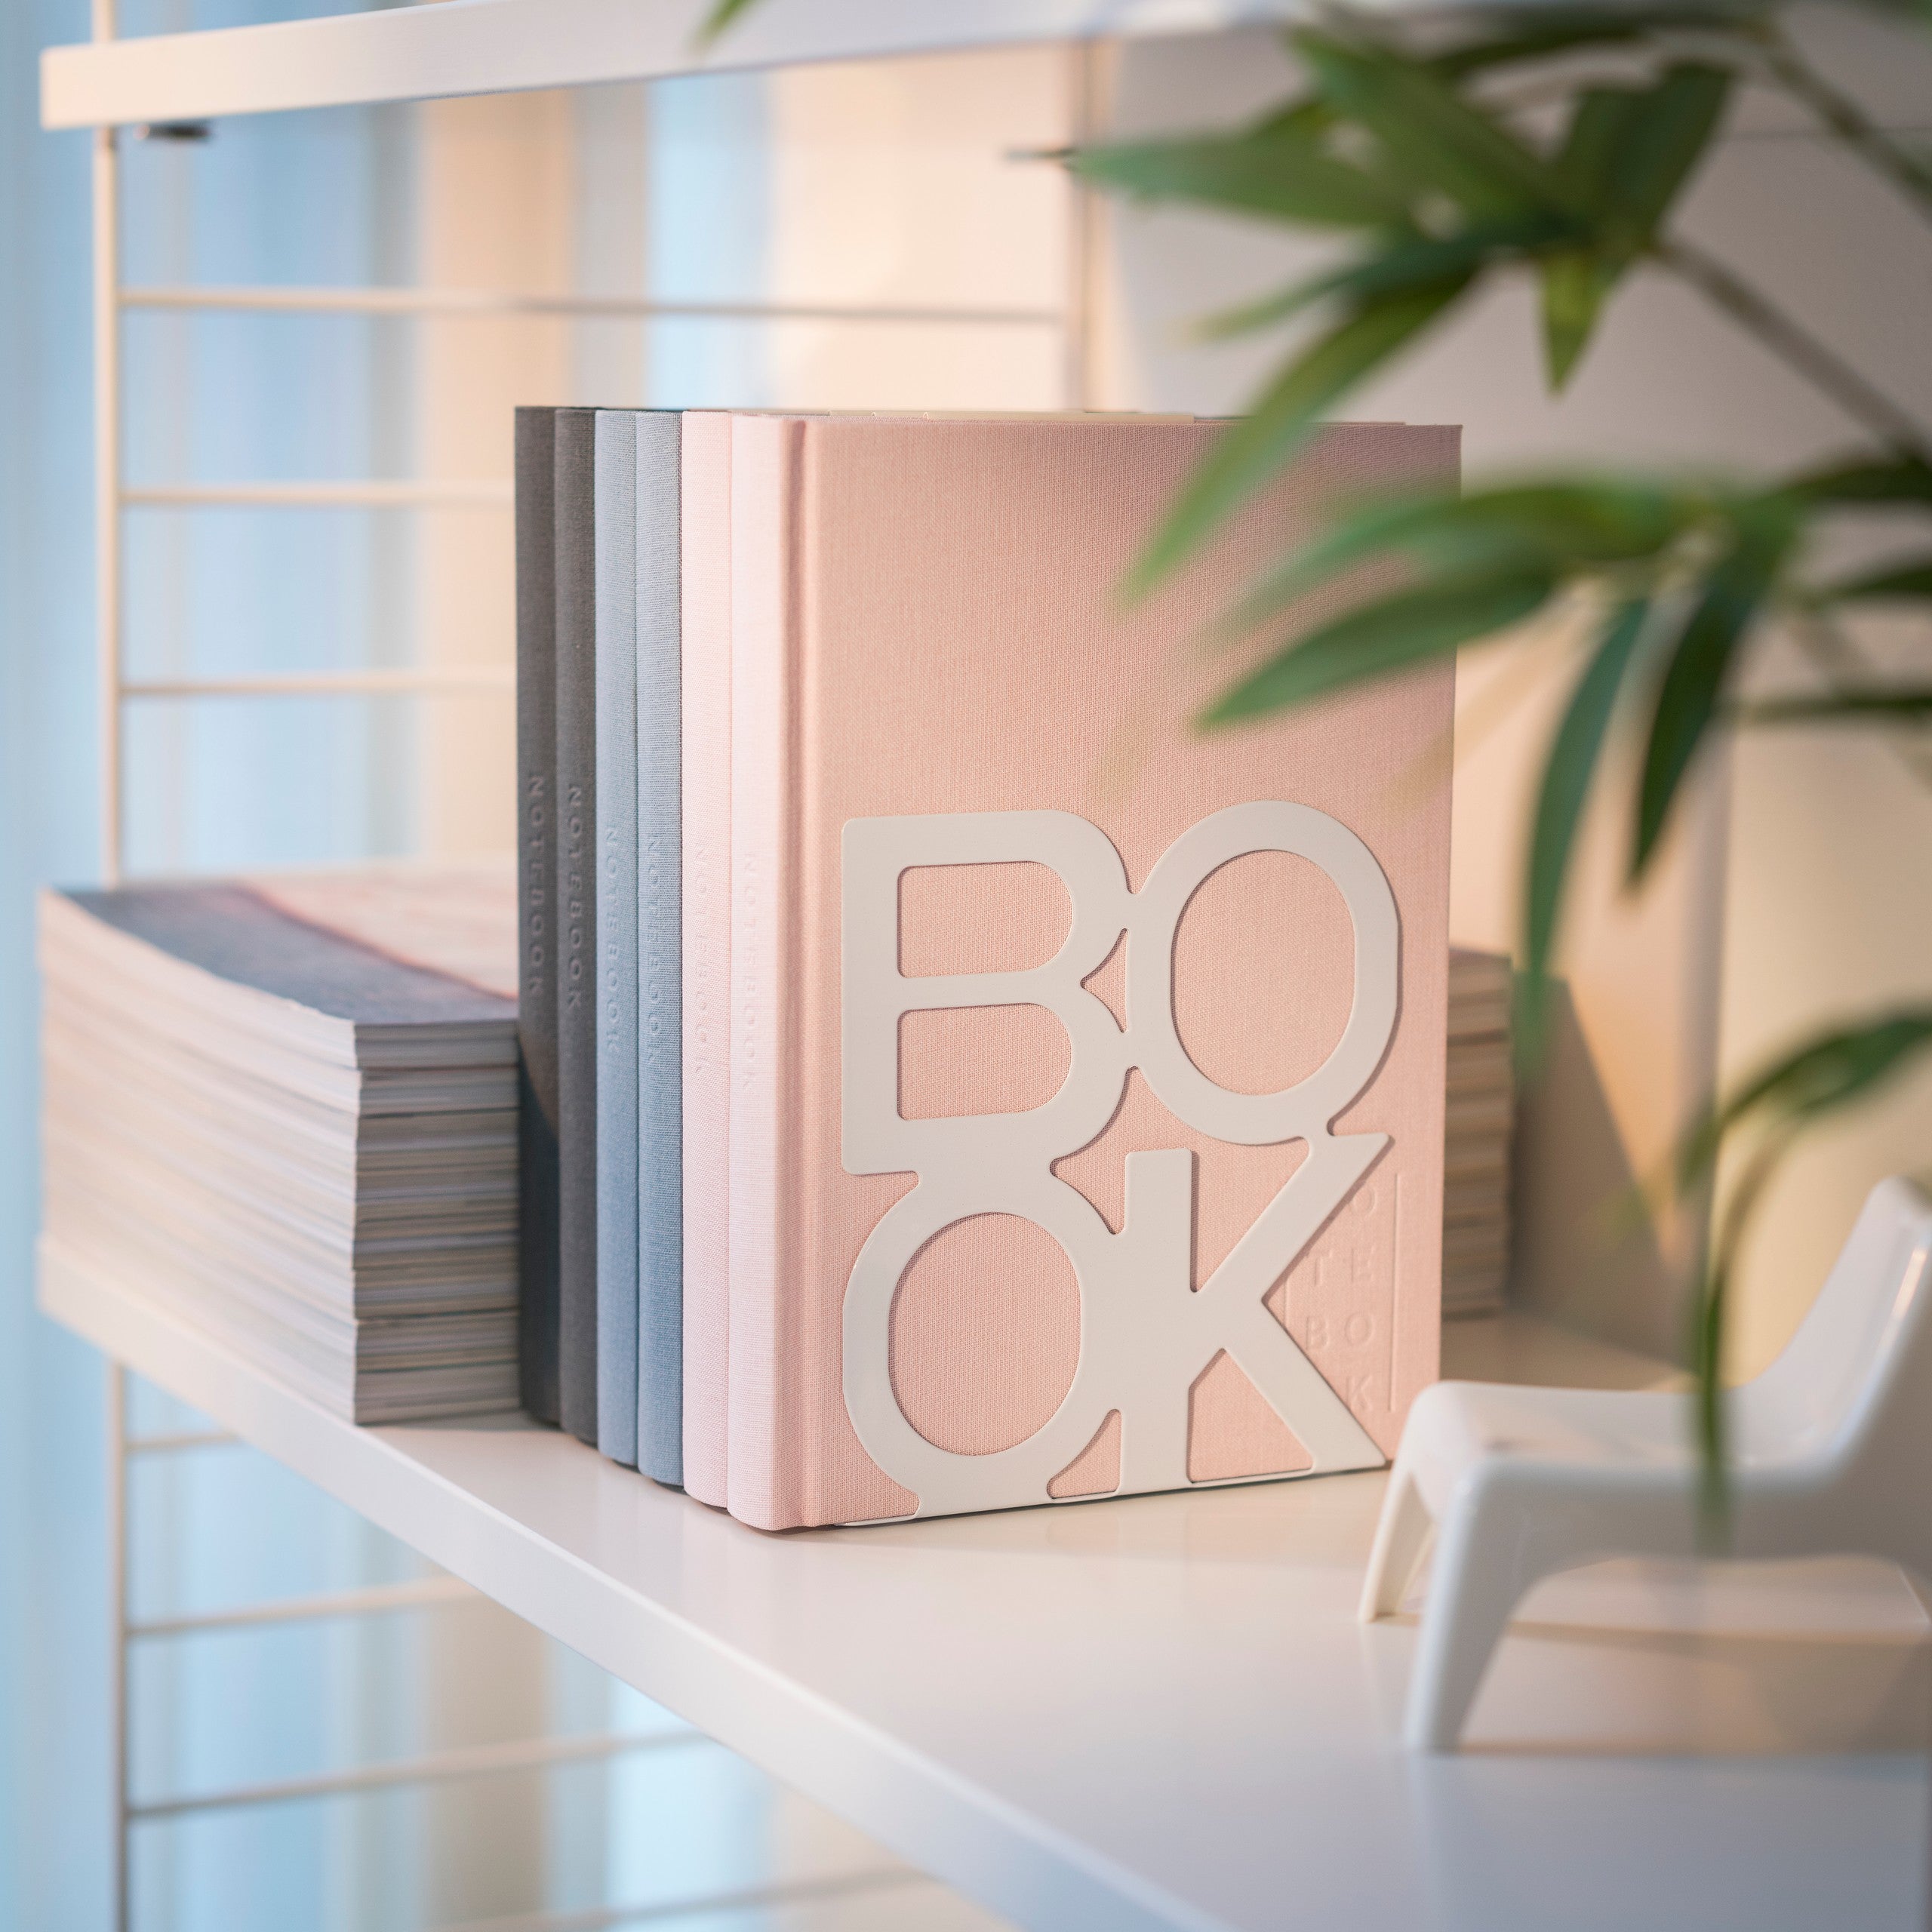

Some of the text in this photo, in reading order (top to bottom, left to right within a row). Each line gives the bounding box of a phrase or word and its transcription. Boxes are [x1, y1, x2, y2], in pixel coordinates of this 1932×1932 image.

[528, 774, 546, 997] NOTEBOOK
[568, 782, 583, 1011] NOTEBOOK
[605, 826, 620, 1054] NOTEBOOK
[647, 835, 662, 1066] NOTEBOOK
[1305, 1310, 1377, 1352] BO
